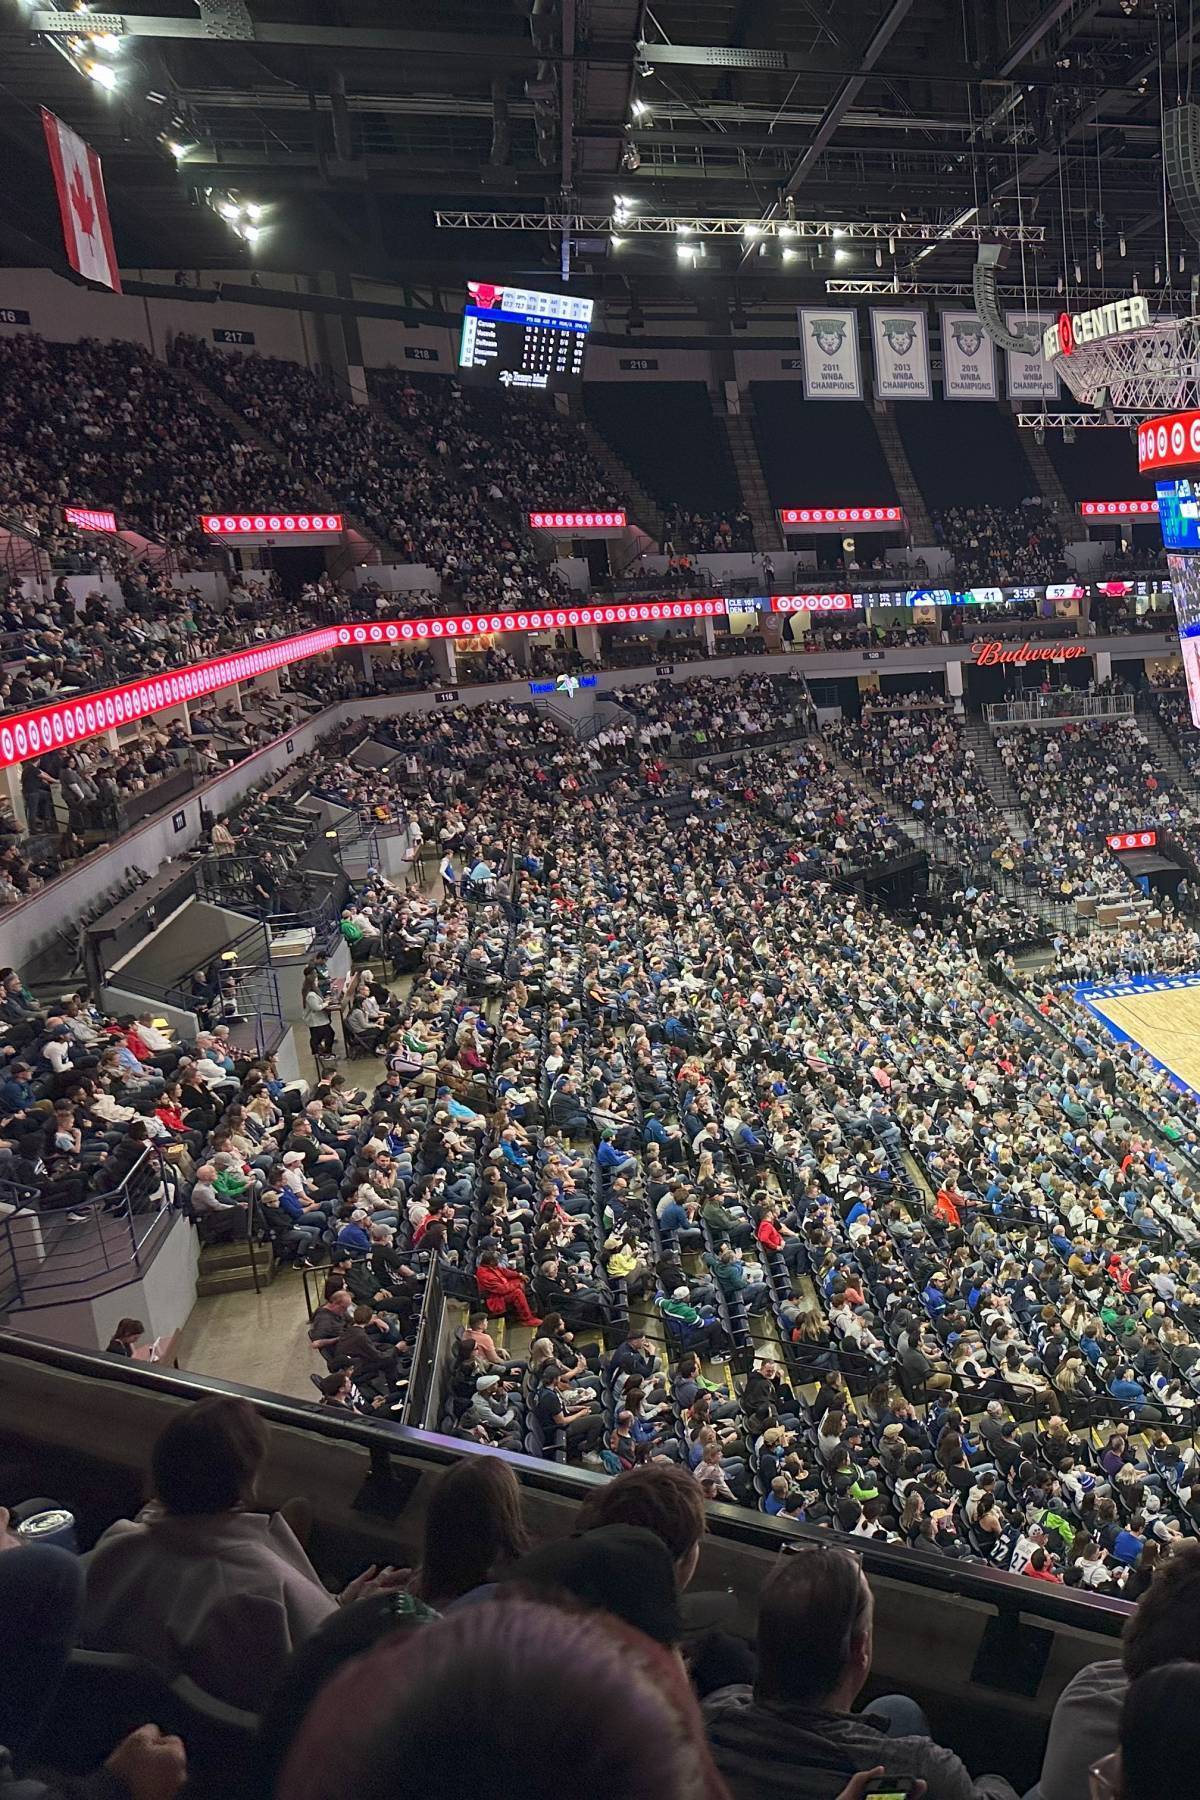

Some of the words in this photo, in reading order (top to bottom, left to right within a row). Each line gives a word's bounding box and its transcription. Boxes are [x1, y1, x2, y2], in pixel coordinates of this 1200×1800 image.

[0, 311, 16, 322] 16
[1073, 296, 1149, 345] CENTER
[224, 331, 243, 343] 217
[414, 350, 430, 359] 218
[631, 361, 648, 369] 219
[791, 361, 802, 369] 22
[822, 363, 839, 371] 2011
[893, 363, 911, 371] 2013
[961, 364, 978, 372] 2015
[1024, 364, 1040, 372] 2017
[821, 372, 843, 380] WNBA
[892, 372, 914, 380] WNBA
[811, 381, 855, 390] CHAMPIONS
[882, 381, 925, 389] CHAMPIONS
[950, 382, 991, 390] CHAMPIONS
[1013, 382, 1054, 390] CHAMPIONS
[984, 592, 995, 601] 41
[1013, 588, 1036, 599] 3:56
[1054, 588, 1065, 598] 52
[728, 599, 742, 607] CLE
[971, 640, 1087, 667] Budweiser
[441, 693, 453, 701] 116
[990, 1539, 1009, 1561] 22
[1011, 1552, 1028, 1572] 27
